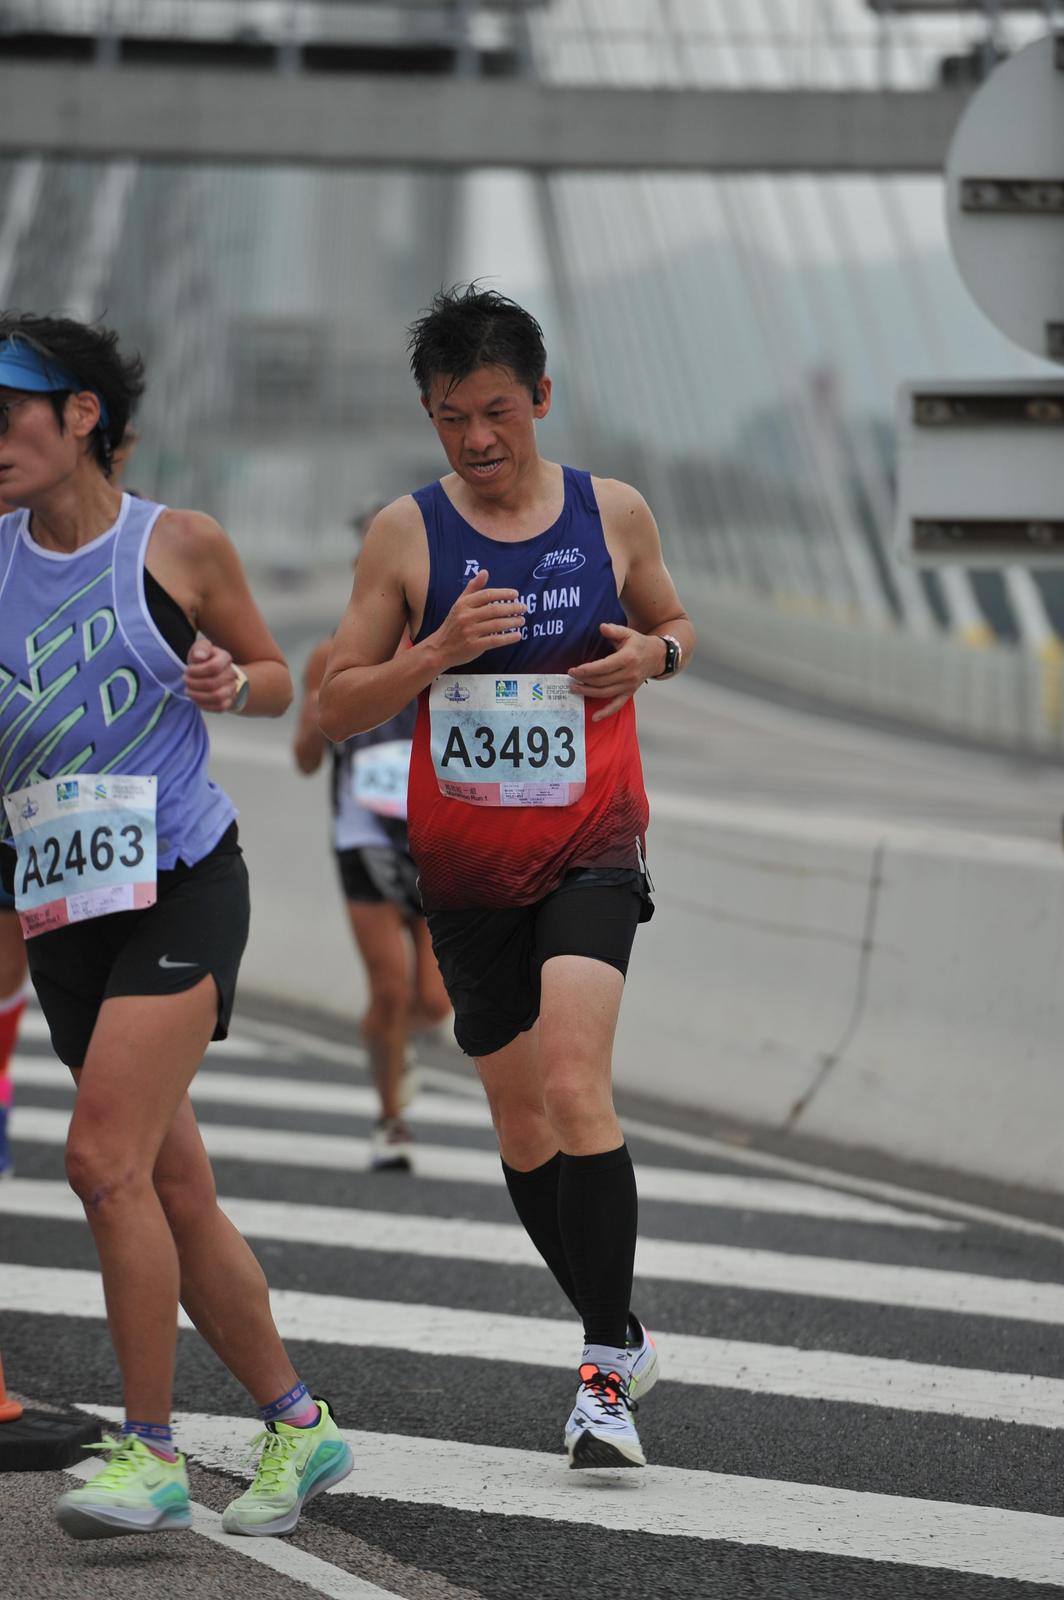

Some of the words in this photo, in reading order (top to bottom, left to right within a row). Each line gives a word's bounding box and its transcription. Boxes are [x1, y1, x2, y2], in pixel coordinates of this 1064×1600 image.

[543, 586, 581, 612] MAN
[533, 619, 564, 638] CLUB
[441, 725, 576, 769] A3493
[21, 824, 145, 895] A2463
